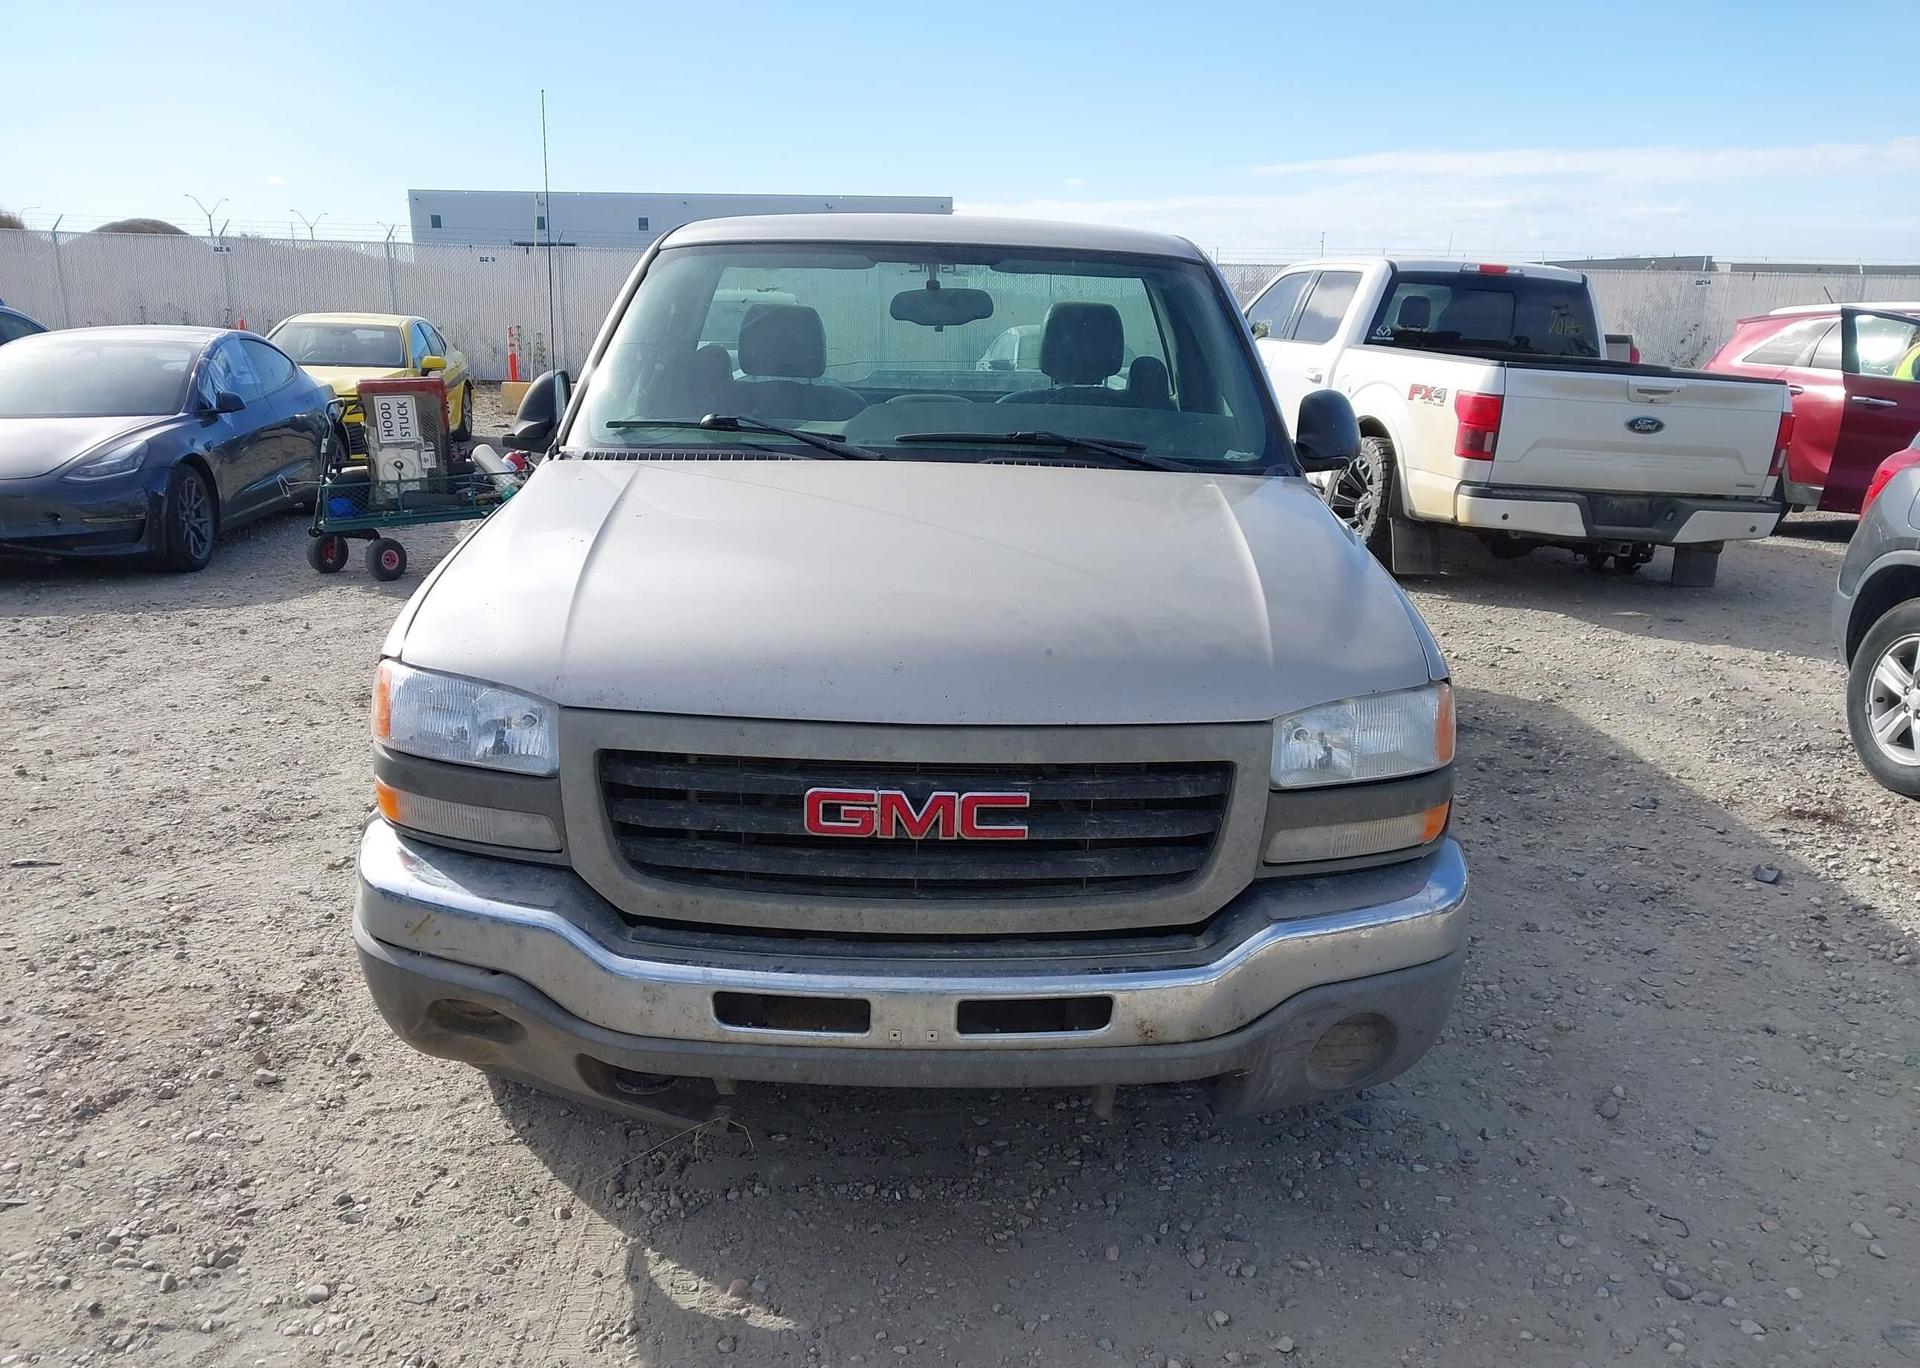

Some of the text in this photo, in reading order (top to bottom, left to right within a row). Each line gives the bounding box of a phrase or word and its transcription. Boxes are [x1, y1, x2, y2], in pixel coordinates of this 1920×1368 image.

[1407, 383, 1448, 404] FX4
[380, 401, 394, 437] HOOD
[396, 401, 411, 438] STUCK
[1634, 418, 1657, 431] Ford
[803, 787, 1031, 841] GMC
